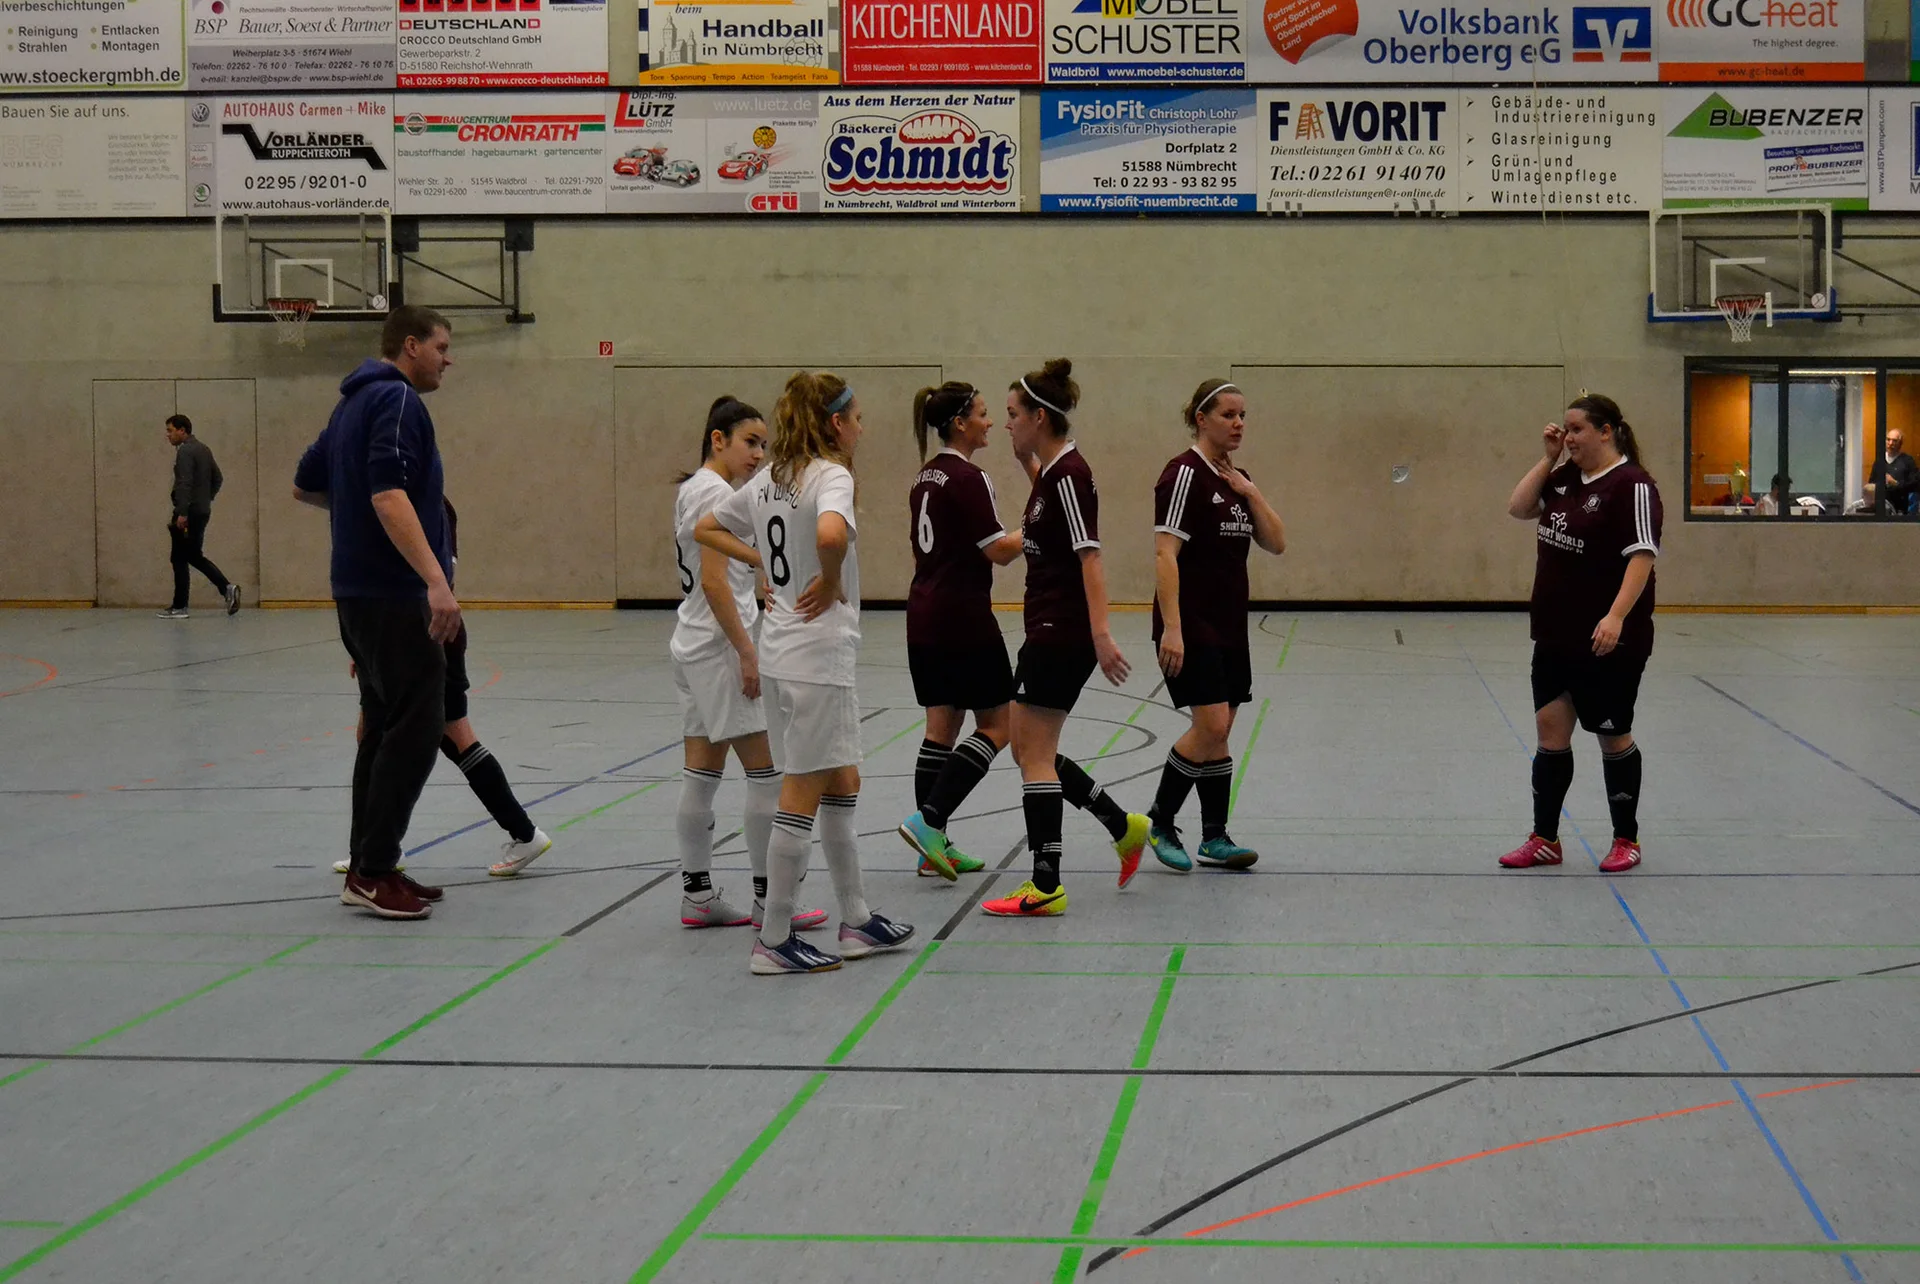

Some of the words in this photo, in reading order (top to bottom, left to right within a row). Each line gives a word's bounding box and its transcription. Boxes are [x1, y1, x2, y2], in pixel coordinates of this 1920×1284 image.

[289, 5, 334, 13] Steuerberater
[337, 5, 393, 13] Wirtschaftsprüfer
[675, 4, 702, 14] beim
[1267, 2, 1297, 23] Partner
[400, 18, 541, 30] DEUTSCHLAND
[852, 3, 1033, 39] KITCHENLAND
[1272, 18, 1288, 31] und
[1288, 6, 1310, 23] Sport
[1277, 4, 1338, 41] Oberbergischen
[1398, 7, 1560, 35] Volksbank
[102, 25, 160, 36] Entlacken
[194, 18, 228, 34] BSP
[238, 17, 282, 35] Bauer,
[285, 17, 321, 33] Soest
[324, 17, 337, 32] &
[341, 16, 393, 33] Partner
[702, 19, 824, 38] Handball
[18, 26, 78, 39] Reinigung
[400, 36, 446, 45] CROCCO
[448, 35, 510, 45] Deutschland
[512, 35, 542, 44] GmbH
[1051, 24, 1241, 55] SCHUSTER
[1281, 35, 1302, 51] Land
[1752, 38, 1769, 48] The
[1771, 38, 1803, 49] highest
[1805, 39, 1839, 49] degree.
[18, 42, 68, 53] Strahlen
[102, 41, 160, 53] Montagen
[232, 49, 281, 59] Weiherplatz
[282, 49, 296, 57] 3-5
[302, 49, 327, 57] 51674
[329, 48, 353, 57] Wiehl
[702, 43, 718, 56] in
[724, 43, 823, 56] Nümbrecht
[400, 49, 473, 59] Gewerbeparkstr.
[475, 49, 481, 58] 2
[1363, 37, 1512, 71] Oberberg
[1520, 38, 1561, 64] eG
[192, 63, 225, 71] Telefon:
[226, 62, 251, 70] 02262
[294, 61, 327, 70] Telefax:
[328, 61, 353, 69] 02262
[400, 61, 438, 71] D-51580
[440, 61, 533, 71] Reichshof-Wehnrath
[873, 63, 905, 72] Nümbrecht
[909, 63, 919, 72] Tel.
[974, 63, 1033, 72] www.kitchenland.de
[1051, 66, 1100, 78] Waldbröl
[1107, 66, 1244, 78] www.moebel-schuster.de
[1718, 67, 1805, 78] www.gc-heat.de
[201, 76, 228, 84] e-mail:
[231, 75, 302, 84] kanzlei@bspw.de
[309, 73, 384, 83] www.bsp-wiehl.de
[401, 77, 415, 86] Tel.
[486, 75, 606, 86] www.crocco-deutschland.de
[670, 73, 706, 82] Spannung
[712, 73, 736, 82] Tempo
[741, 73, 765, 81] Action
[771, 73, 806, 82] Teamgeist
[812, 73, 828, 81] Fans
[631, 91, 677, 101] Dipl.-Ing.
[824, 95, 850, 107] Aus
[855, 95, 885, 107] dem
[890, 94, 940, 106] Herzen
[944, 94, 969, 106] der
[973, 94, 1015, 105] Natur
[1492, 95, 1570, 109] Gebäude-
[1577, 95, 1606, 108] und
[223, 102, 294, 118] AUTOHAUS
[300, 102, 343, 117] Carmen
[358, 101, 386, 116] Mike
[628, 102, 675, 118] LÜTZ
[712, 97, 812, 111] www.luetz.de
[2, 106, 46, 118] Bauen
[50, 105, 70, 118] Sie
[74, 104, 98, 118] auf
[102, 105, 130, 118] uns.
[1057, 99, 1145, 124] FysioFit
[1149, 108, 1206, 121] Christoph
[1210, 108, 1238, 119] Lohr
[1709, 108, 1863, 127] BUBENZER
[443, 115, 510, 124] BAUCENTRUM
[645, 118, 673, 128] GmbH
[798, 120, 817, 128] fällig?
[1495, 110, 1656, 126] Industriereinigung
[457, 124, 581, 142] CRONRATH
[839, 123, 897, 134] Bäckerei
[1081, 123, 1120, 135] Praxis
[1122, 123, 1142, 135] für
[1144, 123, 1237, 137] Physiotherapie
[263, 131, 364, 148] VORLÄNDER
[1492, 132, 1612, 148] Glasreinigung
[398, 149, 466, 157] baustoffhandel
[471, 148, 538, 158] hagebaumarkt
[544, 148, 603, 158] gartencenter
[1165, 142, 1225, 155] Dorfplatz
[1229, 143, 1237, 153] 2
[1270, 145, 1355, 158] Dienstleistungen
[1358, 145, 1392, 156] GmbH
[1395, 146, 1404, 156] &
[1408, 145, 1425, 156] Co.
[1429, 145, 1446, 156] KG
[1766, 148, 1794, 158] Besuchen
[1877, 99, 1886, 194] www.ISTPumpen.com
[271, 148, 351, 159] RUPPICHTEROTH
[826, 135, 1011, 180] Schmidt
[1122, 161, 1162, 172] 51588
[1166, 160, 1237, 172] Nümbrecht
[1492, 154, 1538, 167] Grün-
[1544, 154, 1573, 167] und
[1768, 163, 1799, 173] PROFI
[1807, 159, 1863, 170] BUBENZER
[398, 178, 426, 186] Wiehler
[428, 178, 440, 186] Str.
[444, 178, 454, 186] 20
[470, 177, 494, 186] 51545
[495, 176, 528, 186] Waldbröl
[559, 176, 604, 185] 02291-7920
[1093, 177, 1116, 188] Tel:
[1492, 169, 1617, 185] Umlagenpflege
[409, 188, 422, 196] Fax
[423, 187, 467, 196] 02291-6200
[484, 186, 592, 197] www.baucentrum-cronrath.de
[630, 184, 654, 192] gehabt?
[1268, 188, 1446, 200] favorit-dienstleistungen@t-online.de
[223, 198, 390, 210] www.autohaus-vorländer.de
[751, 192, 798, 211] GTÜ
[1058, 195, 1238, 209] www.fysiofit-nuembrecht.de
[1606, 191, 1637, 204] etc.
[824, 200, 835, 209] In
[837, 200, 893, 210] Nümbrecht,
[896, 200, 938, 209] Waldbröl
[941, 200, 960, 209] und
[962, 199, 1016, 209] Winterborn
[918, 491, 934, 554] 6
[1220, 521, 1240, 532] SHIRT
[1555, 531, 1584, 549] WORLD
[767, 515, 791, 587] 8
